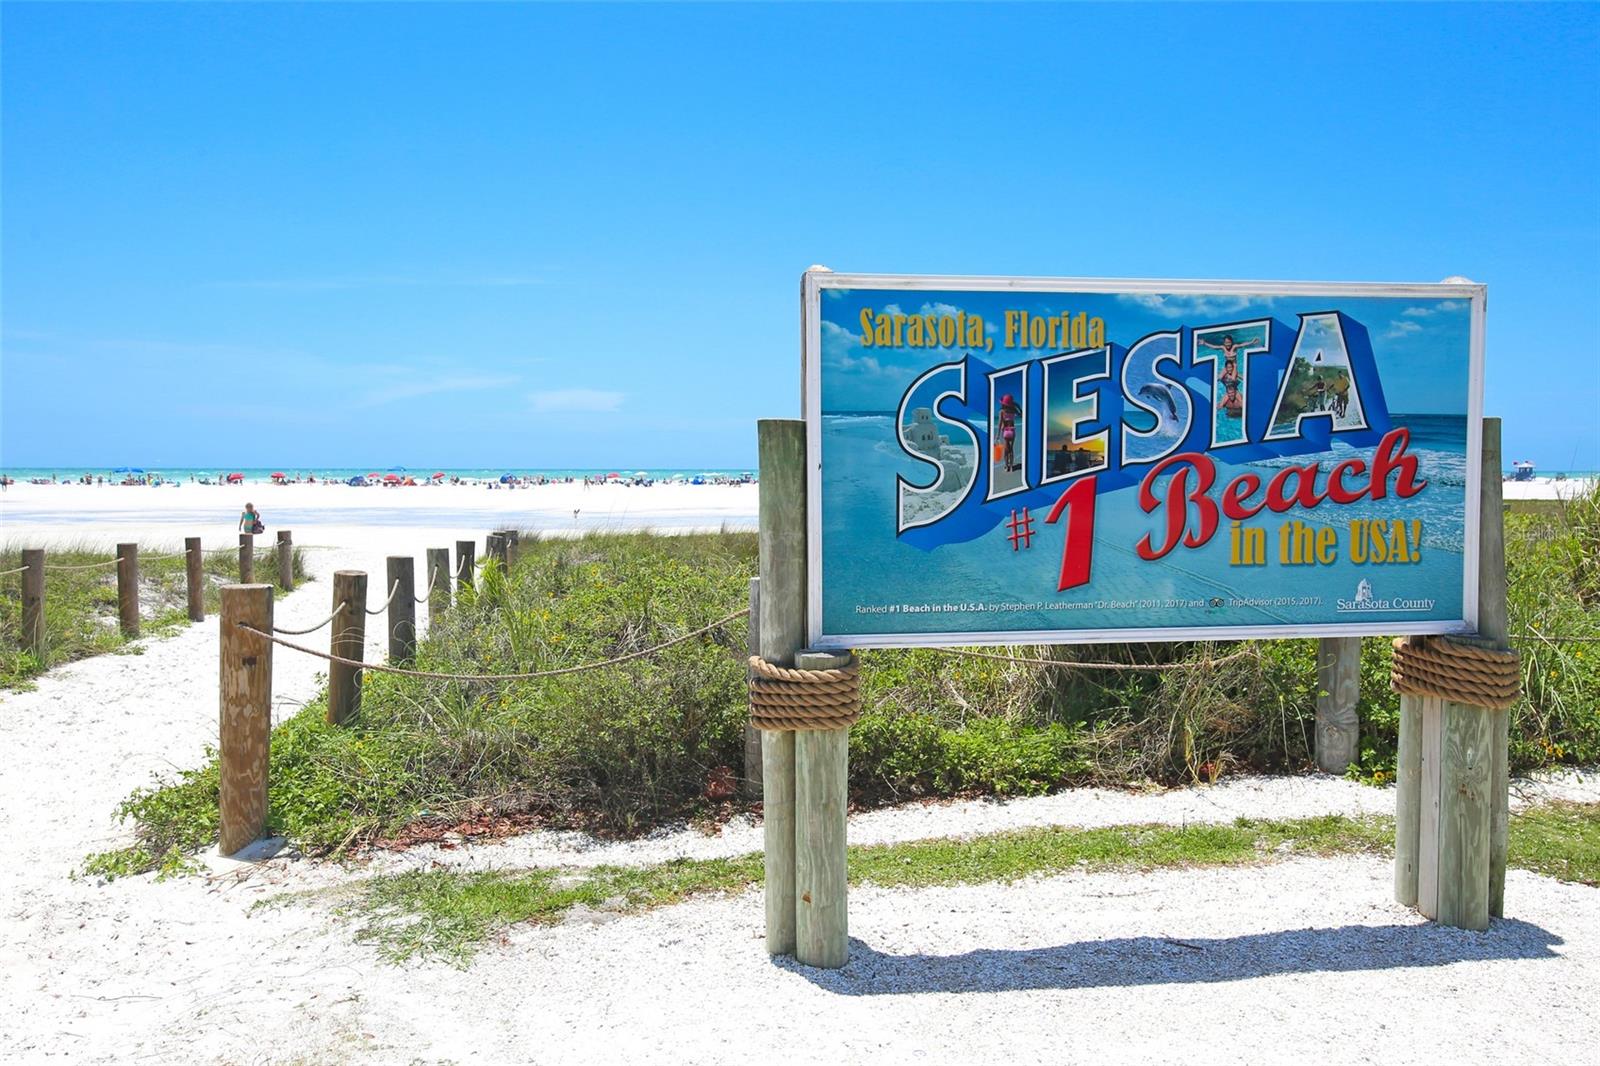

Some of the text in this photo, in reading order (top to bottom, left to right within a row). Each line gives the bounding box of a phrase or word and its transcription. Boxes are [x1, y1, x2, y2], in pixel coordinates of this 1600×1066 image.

[859, 307, 1105, 352] Sarasota, Florida
[896, 310, 1370, 537] SIESTA
[1006, 427, 1428, 593] #1 Beach
[1229, 519, 1422, 566] in the USA!
[855, 604, 888, 614] Ranked
[889, 604, 900, 613] #1
[902, 603, 931, 613] Beach
[932, 603, 942, 612] in
[943, 603, 959, 612] the
[960, 602, 988, 612] U.S.A.
[989, 602, 1000, 613] by
[1000, 601, 1036, 613] Stephen
[1037, 602, 1044, 610] P.
[1045, 600, 1094, 610] Leatherman
[1188, 600, 1205, 608] and
[1229, 598, 1272, 609] TripAdvisor
[1336, 597, 1435, 611] Sarasota County
